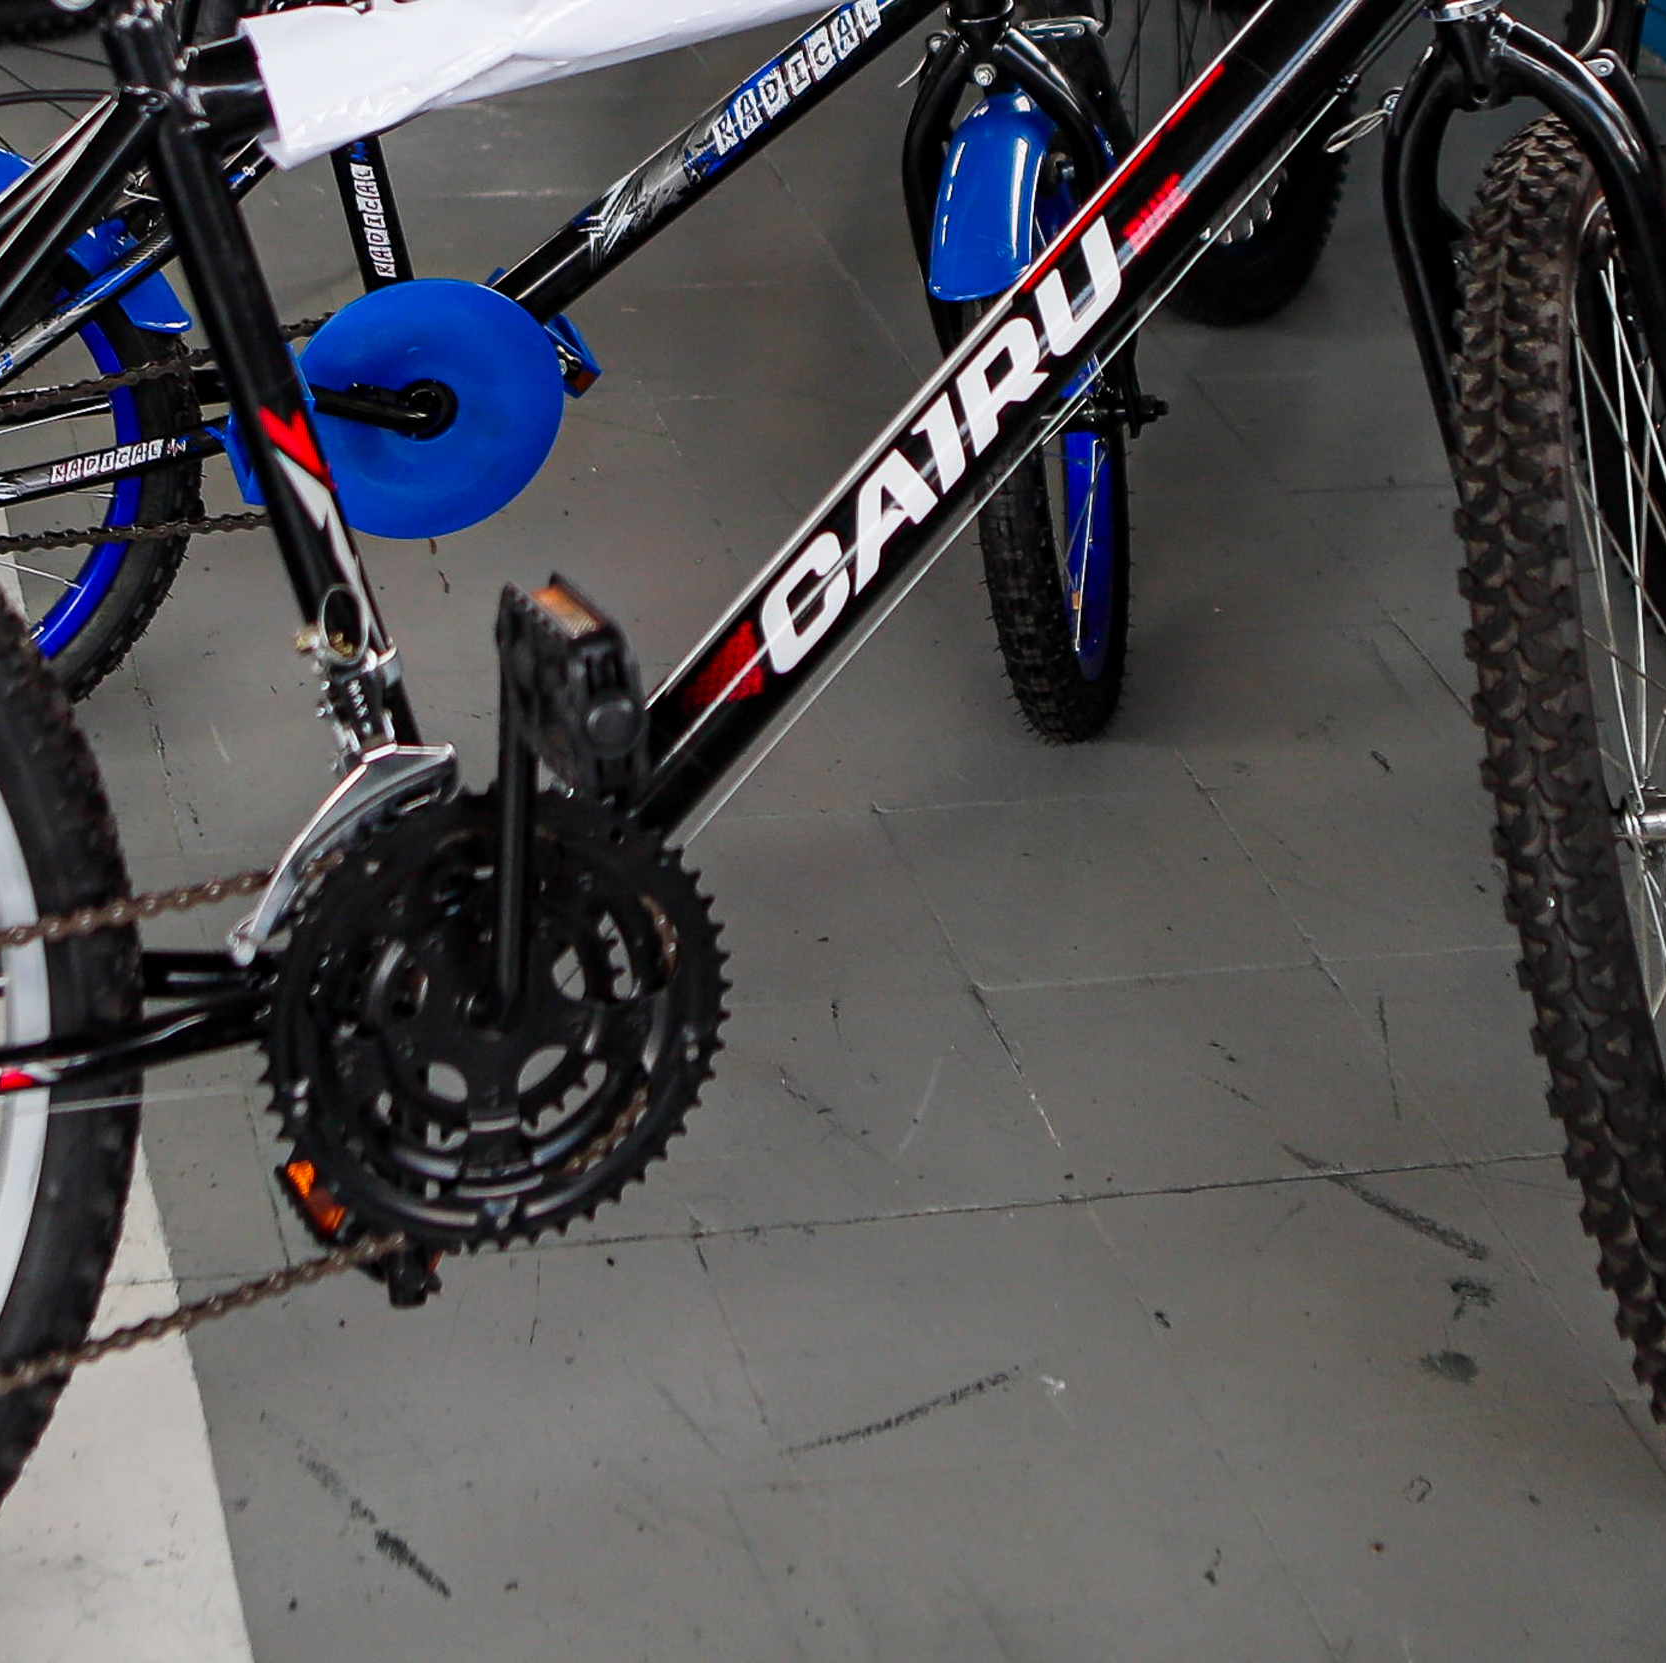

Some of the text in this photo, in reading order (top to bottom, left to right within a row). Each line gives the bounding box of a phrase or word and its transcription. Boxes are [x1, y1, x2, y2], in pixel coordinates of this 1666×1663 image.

[349, 162, 397, 278] RADICAL
[49, 438, 165, 485] RADICAL
[761, 214, 1124, 674] CAIRU
